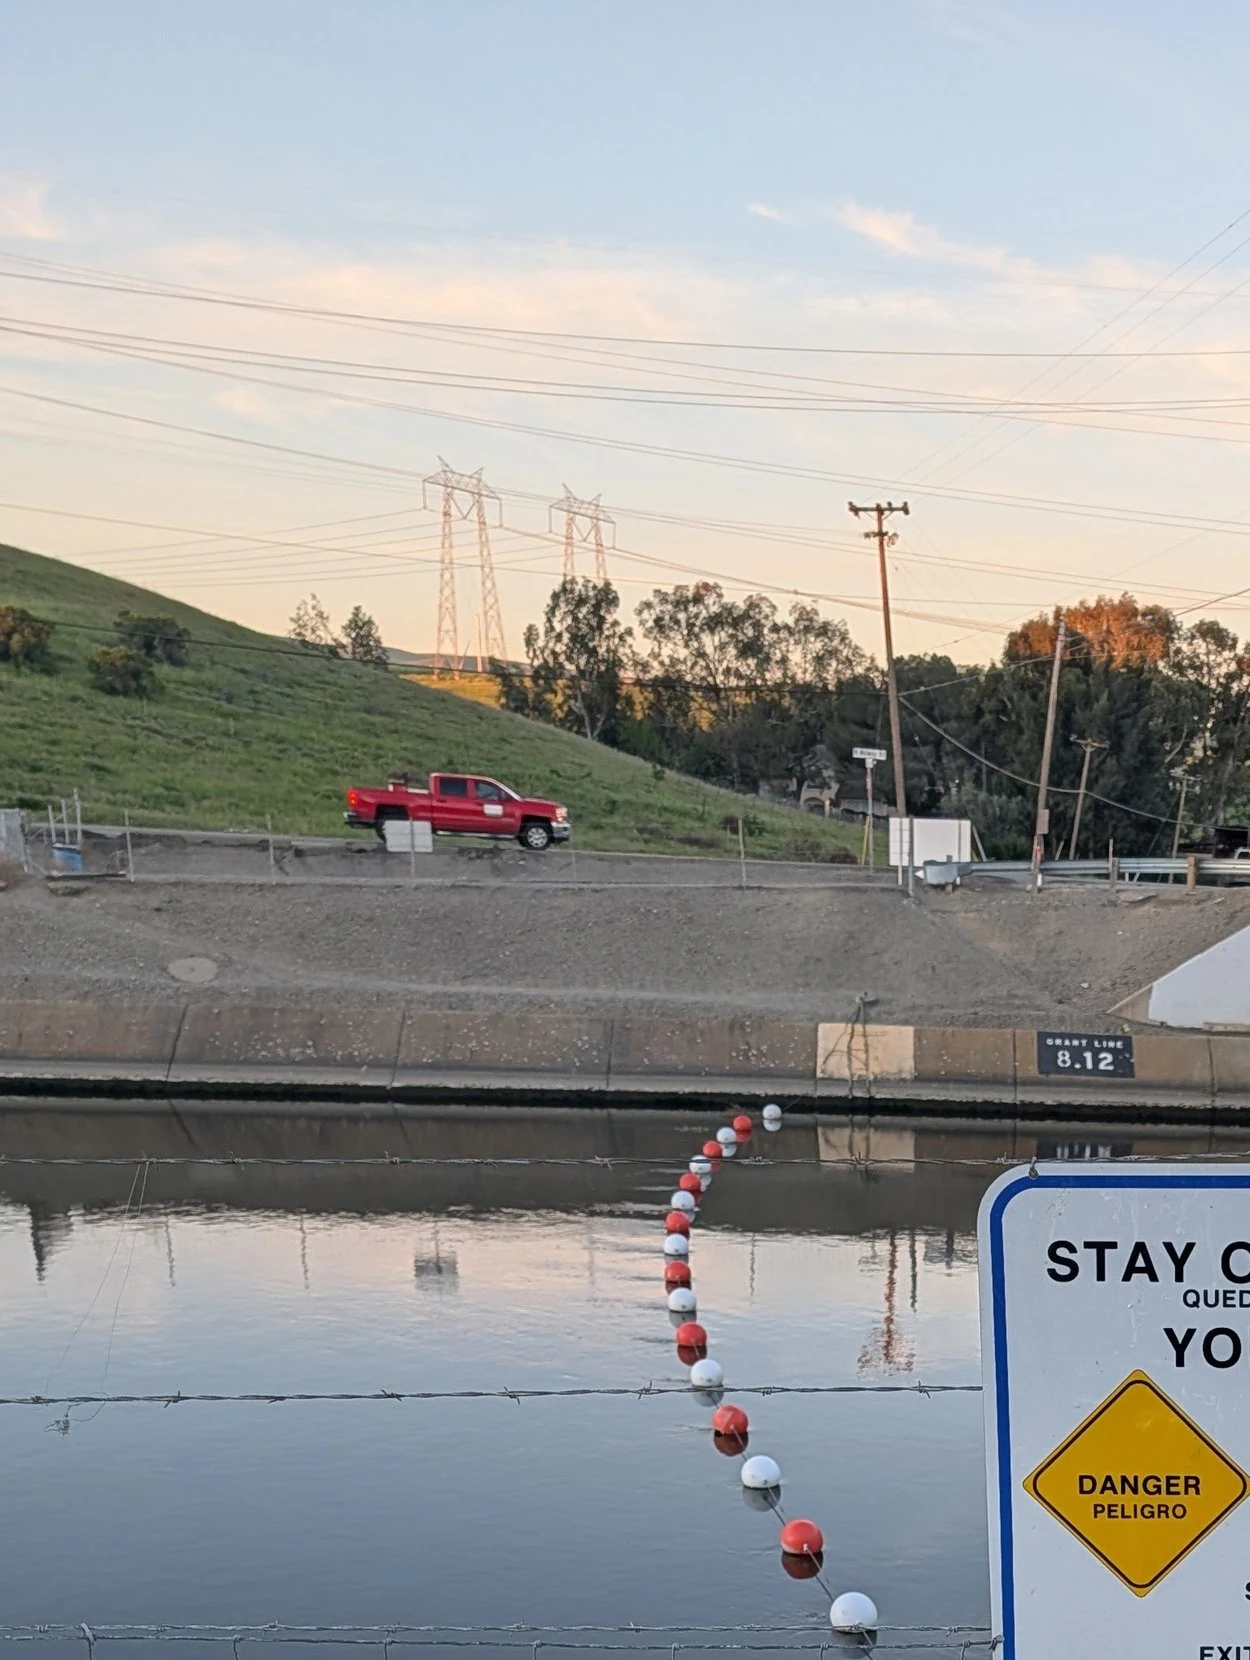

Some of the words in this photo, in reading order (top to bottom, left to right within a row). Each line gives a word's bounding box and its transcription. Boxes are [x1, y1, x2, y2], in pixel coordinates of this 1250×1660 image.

[1045, 1038, 1088, 1047] GRANT
[1093, 1040, 1124, 1049] LINE
[1056, 1049, 1115, 1071] 8.12
[1046, 1240, 1197, 1283] STAY
[1078, 1474, 1201, 1496] DANGER
[1093, 1503, 1188, 1520] PELIGRO
